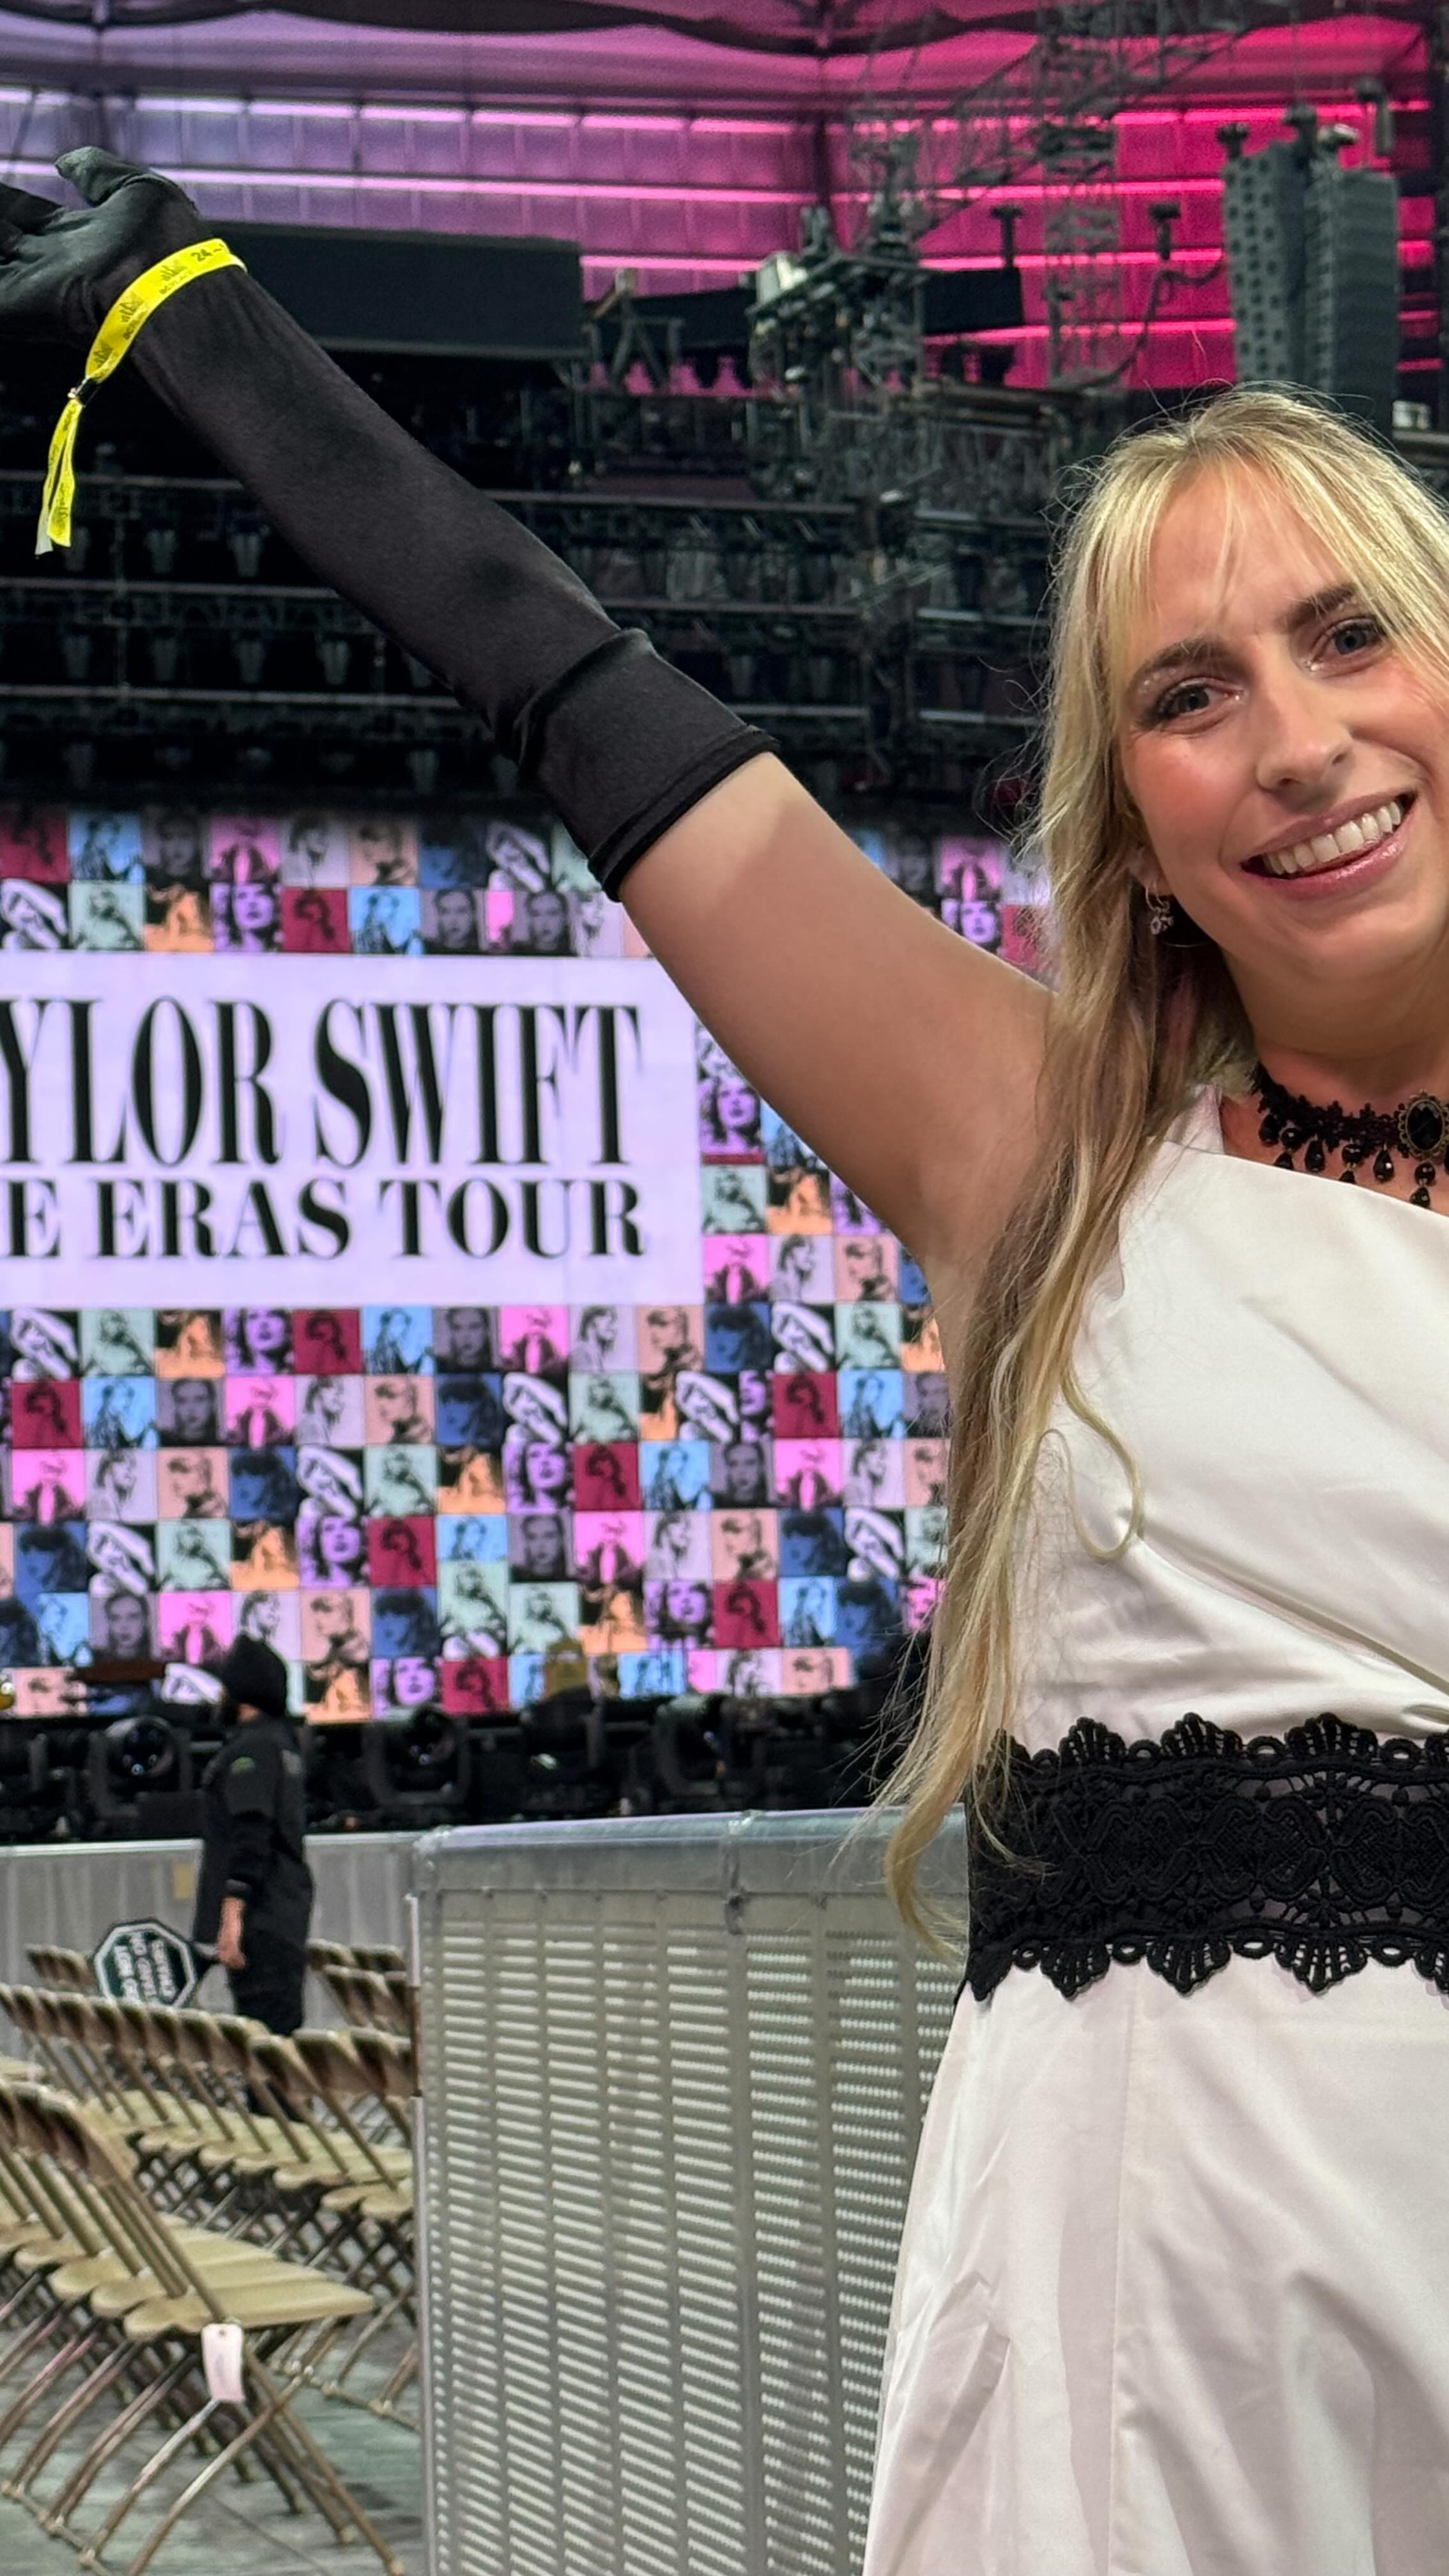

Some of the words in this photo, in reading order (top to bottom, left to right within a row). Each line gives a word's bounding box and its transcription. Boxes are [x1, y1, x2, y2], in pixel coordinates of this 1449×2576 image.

[0, 995, 285, 1167] YLOR
[313, 997, 643, 1169] SWIFT
[92, 1177, 352, 1261] ERAS
[378, 1177, 645, 1261] TOUR
